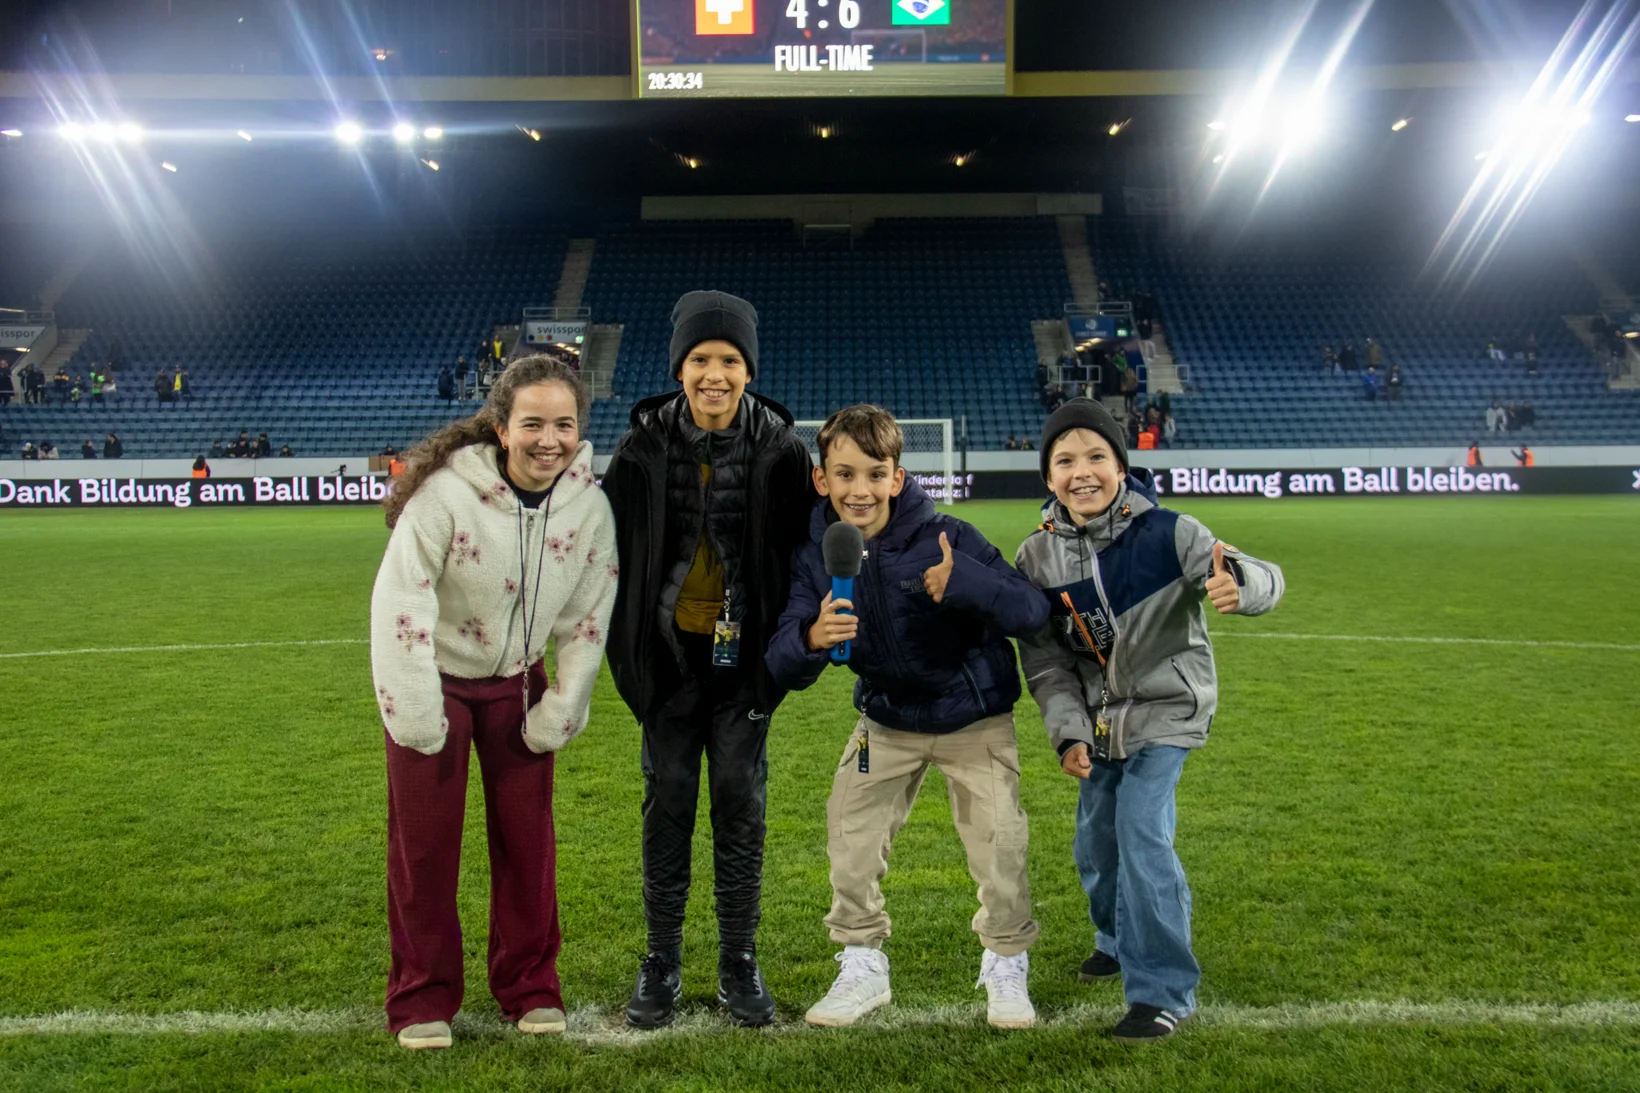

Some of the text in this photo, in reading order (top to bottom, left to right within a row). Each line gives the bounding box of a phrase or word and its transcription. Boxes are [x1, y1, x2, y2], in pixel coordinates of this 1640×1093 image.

[786, 0, 808, 28] 4
[839, 0, 860, 28] 6
[775, 45, 874, 72] FULL-TIME
[648, 72, 703, 90] 20:30:34
[0, 479, 71, 503] Dank
[79, 478, 190, 507] Bildung
[200, 483, 245, 501] am
[254, 477, 309, 501] Ball
[1170, 468, 1282, 498] Bildung
[1289, 473, 1335, 493] am
[1342, 467, 1400, 492] Ball
[1407, 466, 1520, 492] bleiben.
